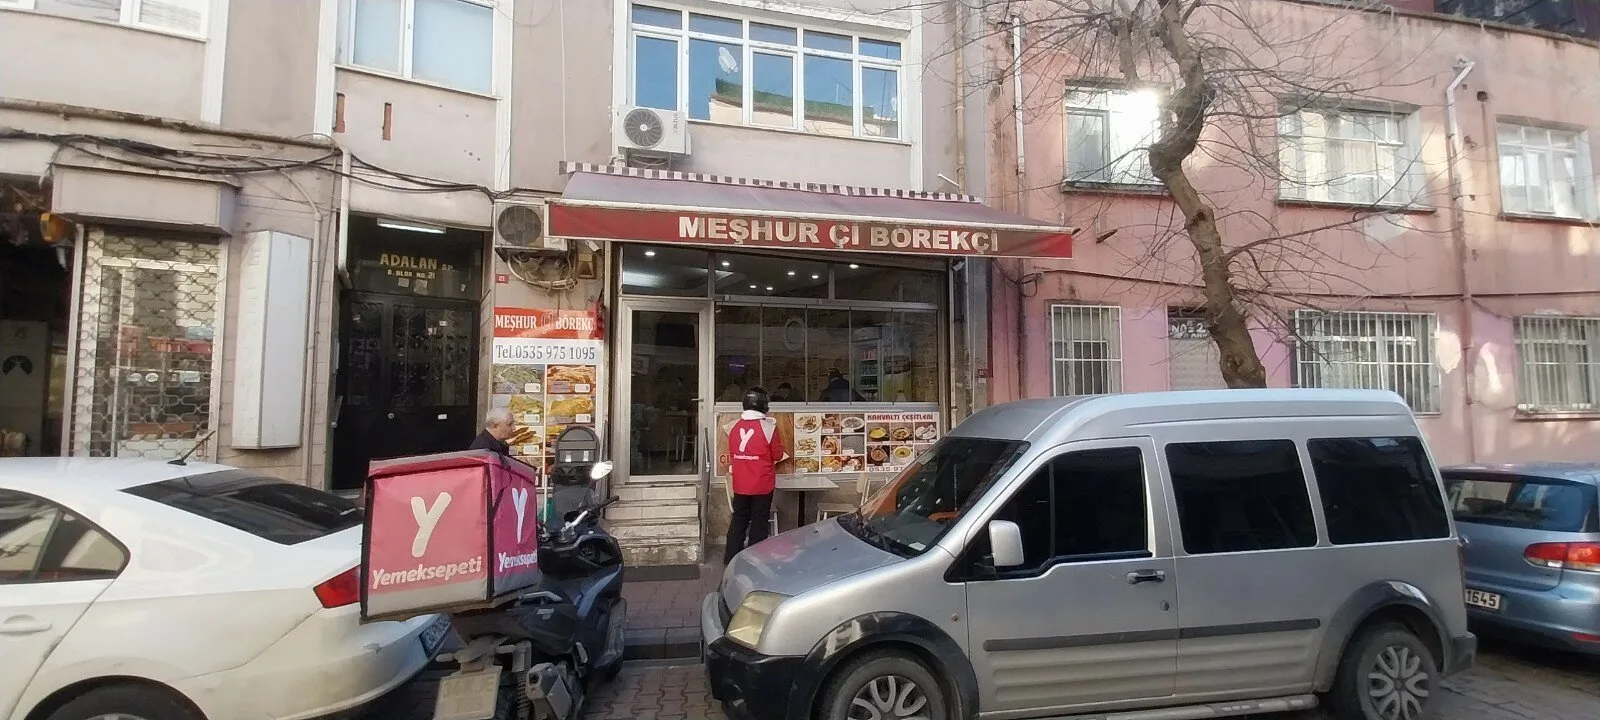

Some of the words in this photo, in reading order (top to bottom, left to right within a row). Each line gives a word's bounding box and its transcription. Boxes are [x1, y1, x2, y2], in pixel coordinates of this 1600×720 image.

[678, 216, 820, 245] MEŞHUR
[380, 253, 437, 270] ADALAN
[495, 315, 537, 332] MEŞHUR
[555, 314, 594, 335] BÖREKÇ
[546, 345, 566, 360] 975
[569, 346, 595, 360] 1095
[738, 427, 755, 453] Y
[410, 491, 452, 558] Y
[372, 555, 482, 590] Yemeksepeti
[1466, 590, 1496, 607] 1645
